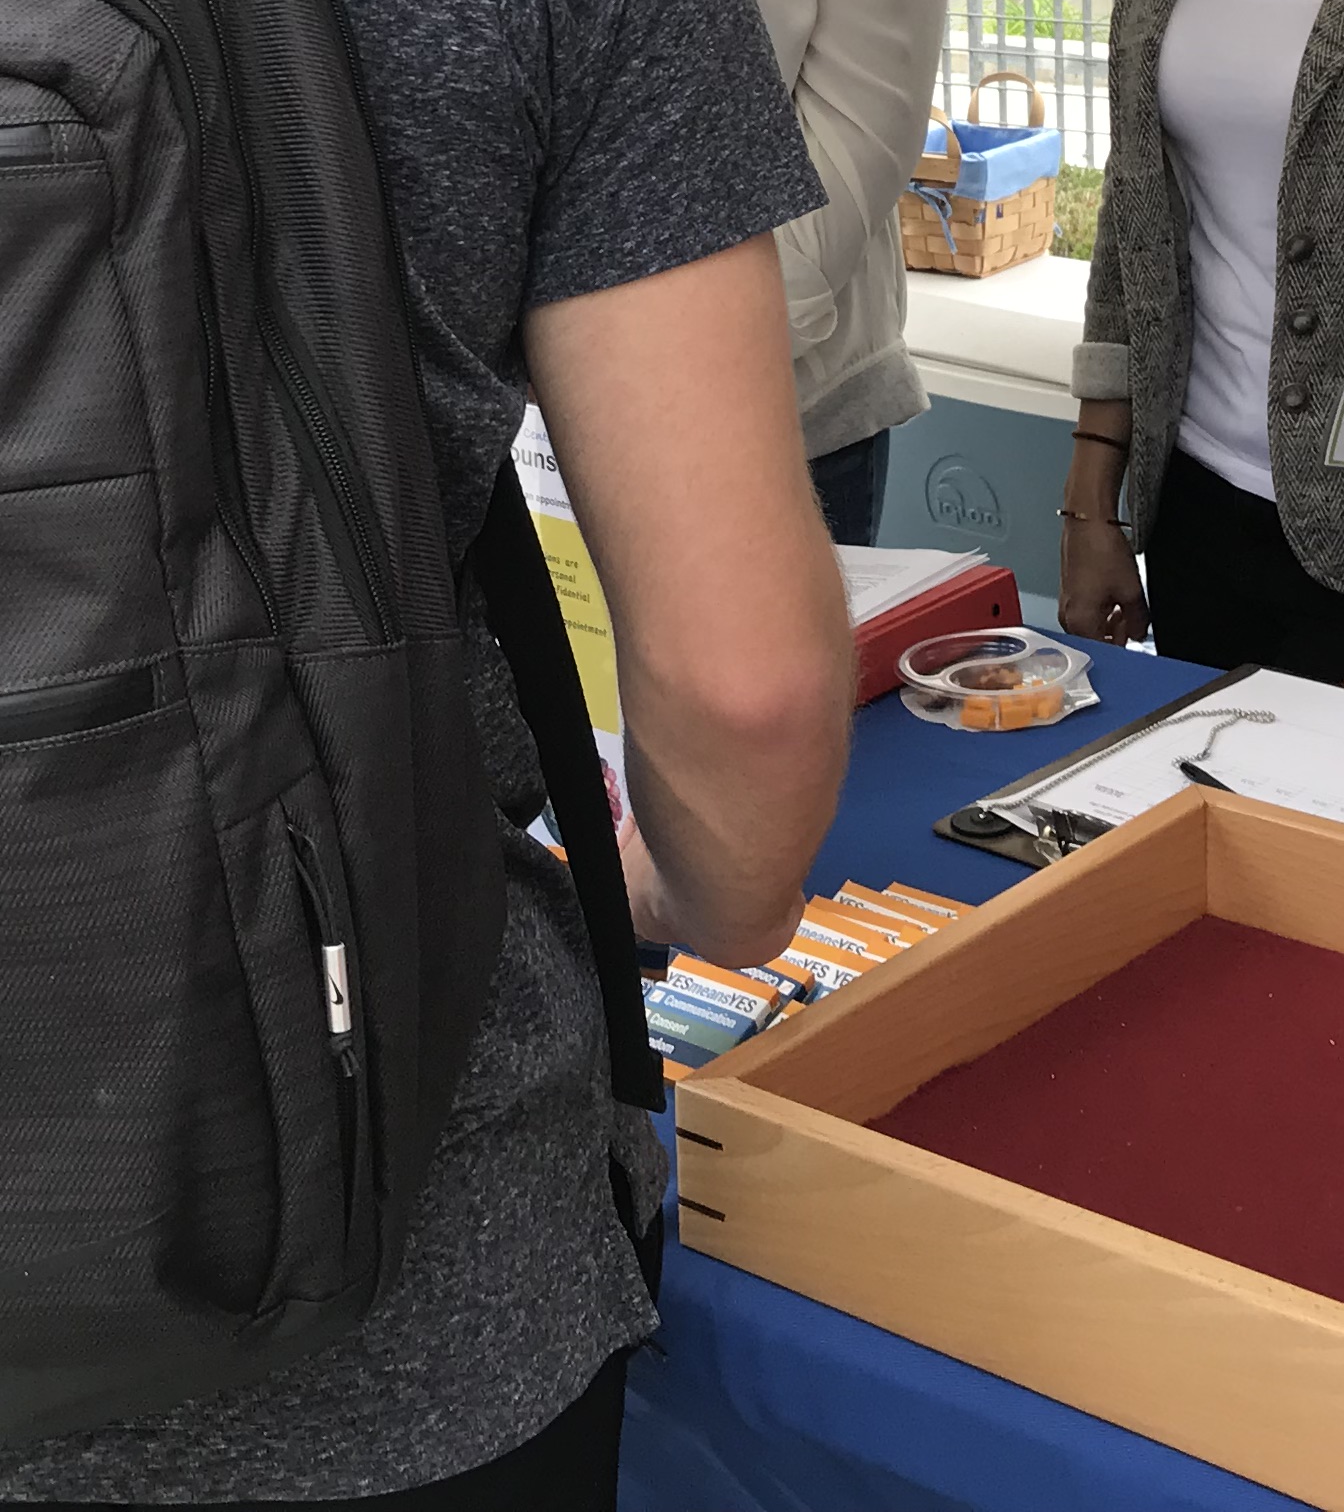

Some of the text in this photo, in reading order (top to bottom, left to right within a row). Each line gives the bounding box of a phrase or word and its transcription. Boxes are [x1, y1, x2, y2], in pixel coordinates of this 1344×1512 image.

[668, 971, 758, 1014] YESmeansYES
[834, 970, 854, 989] YE
[649, 1012, 690, 1036] Consent
[663, 994, 737, 1029] Communication
